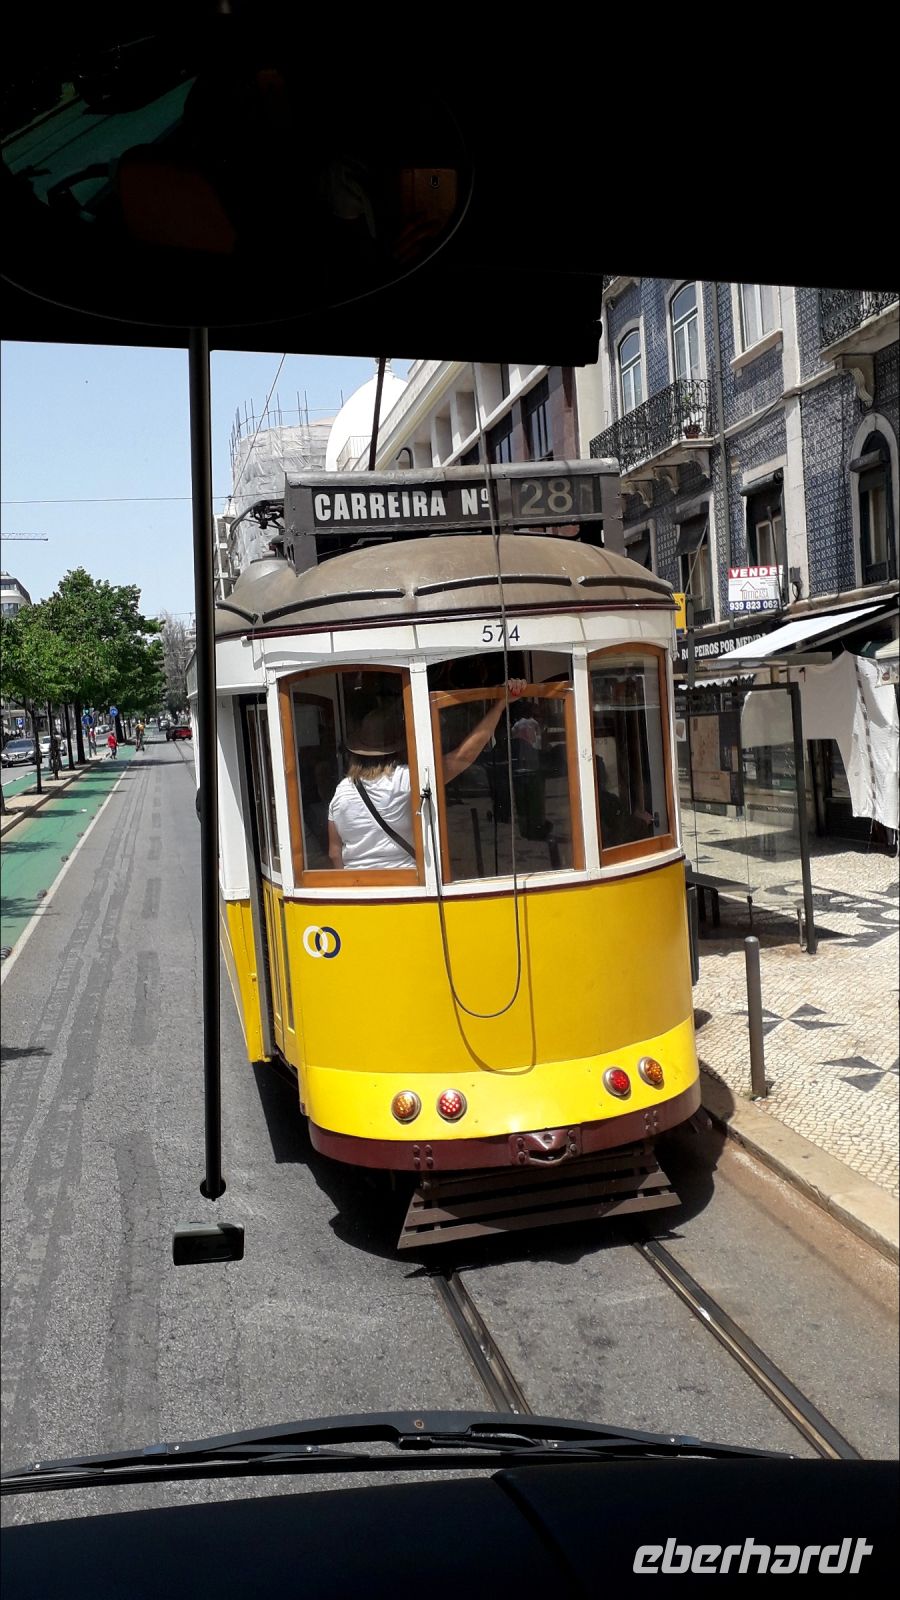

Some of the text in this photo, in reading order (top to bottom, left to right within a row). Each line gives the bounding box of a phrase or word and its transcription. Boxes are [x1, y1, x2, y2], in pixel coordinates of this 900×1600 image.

[314, 490, 447, 521] CARREIRA
[730, 600, 778, 610] 939 823 062
[482, 624, 520, 643] 574
[720, 639, 736, 653] POR
